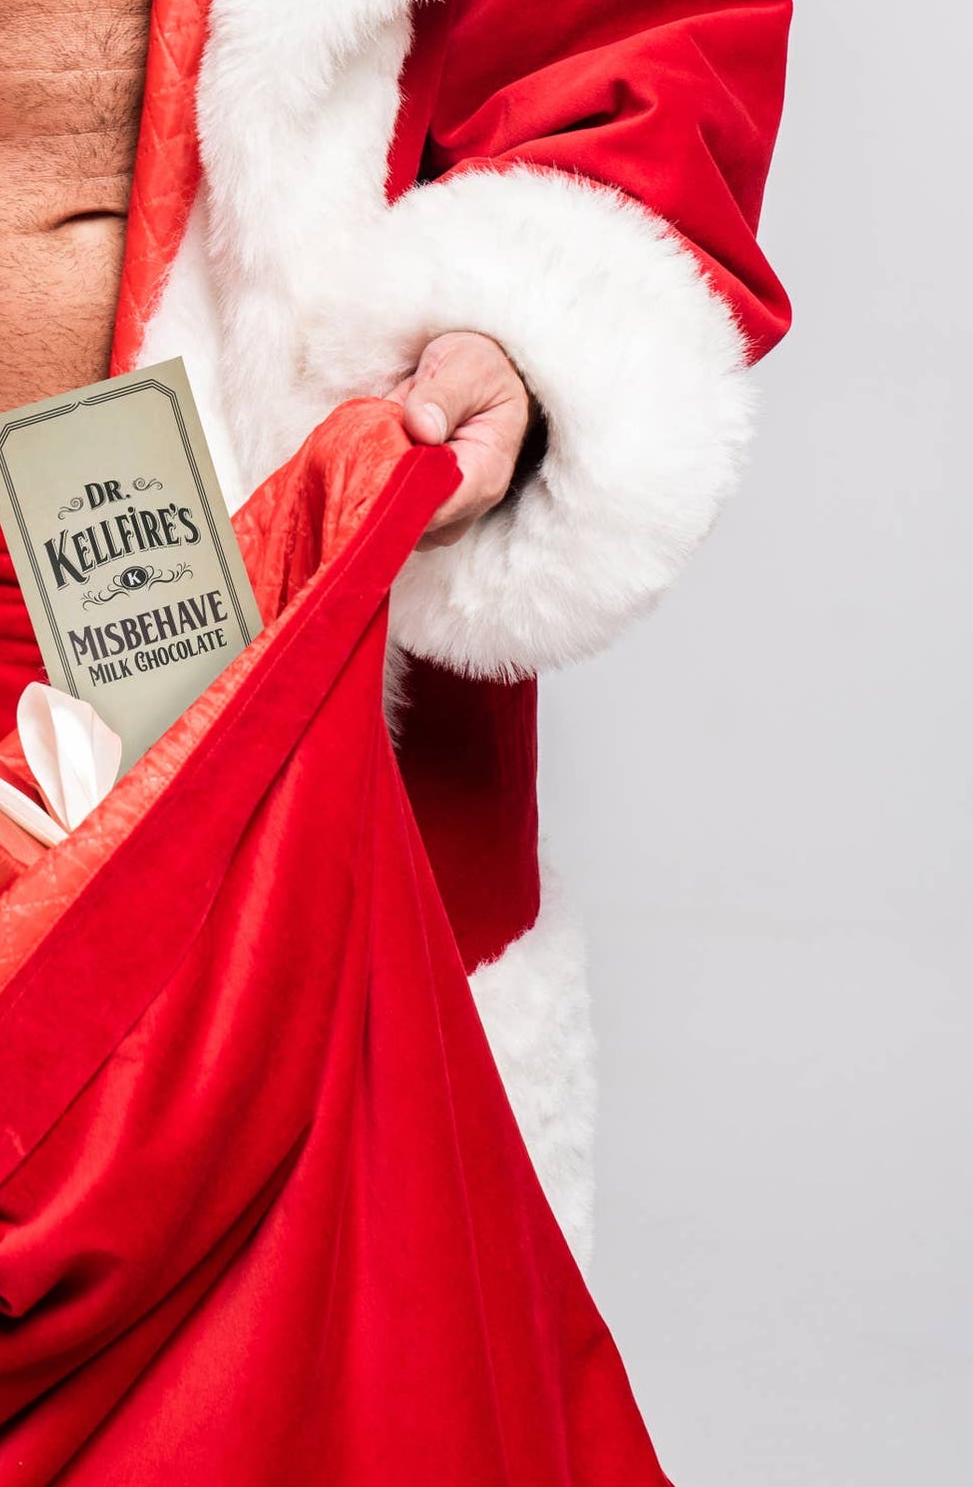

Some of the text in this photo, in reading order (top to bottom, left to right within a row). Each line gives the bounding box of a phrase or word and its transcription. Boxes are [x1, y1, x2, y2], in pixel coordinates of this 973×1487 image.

[67, 590, 228, 666] MISBEHAVE
[88, 628, 228, 687] MILK CHOCOLATE
